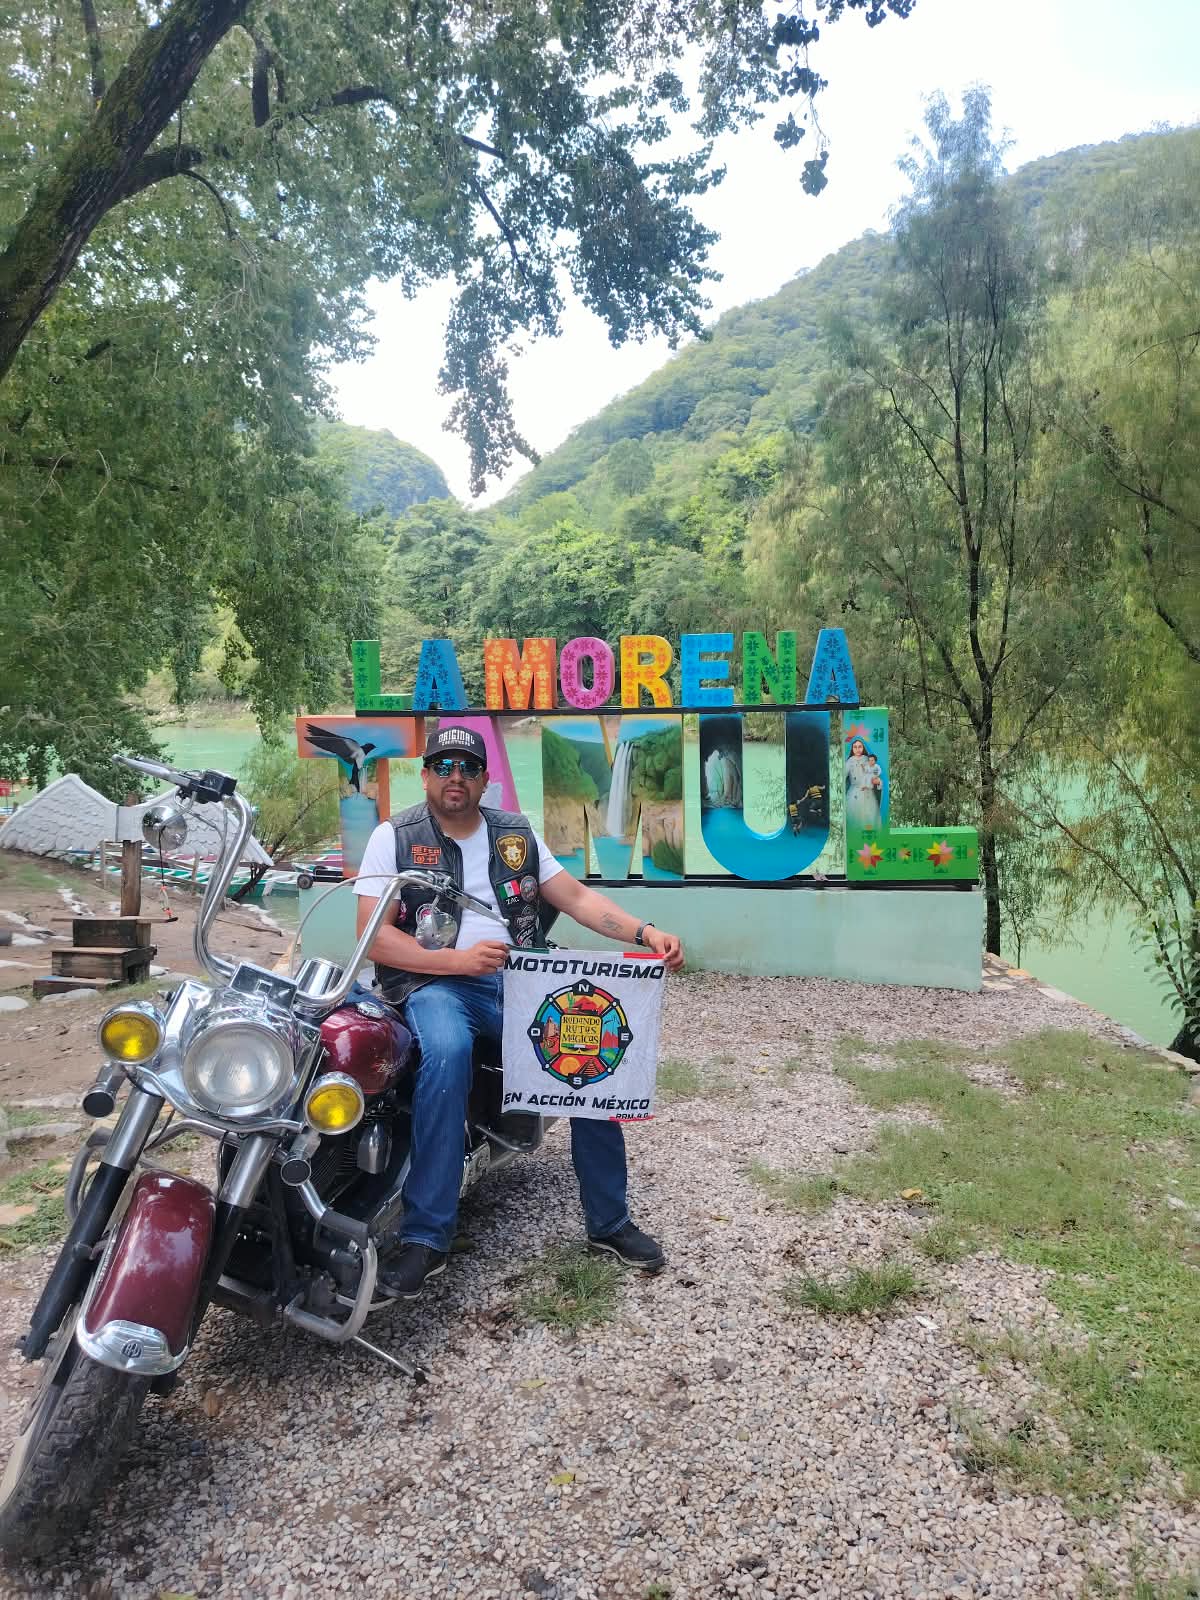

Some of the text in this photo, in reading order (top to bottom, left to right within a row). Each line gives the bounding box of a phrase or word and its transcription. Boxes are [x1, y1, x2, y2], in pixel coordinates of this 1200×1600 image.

[352, 628, 860, 711] LA MORENA
[438, 729, 475, 745] ORIGINAL
[503, 956, 665, 980] MOTOTURISMO
[578, 984, 590, 992] N
[504, 1092, 650, 1110] EN ACCIÓN MÉXICO
